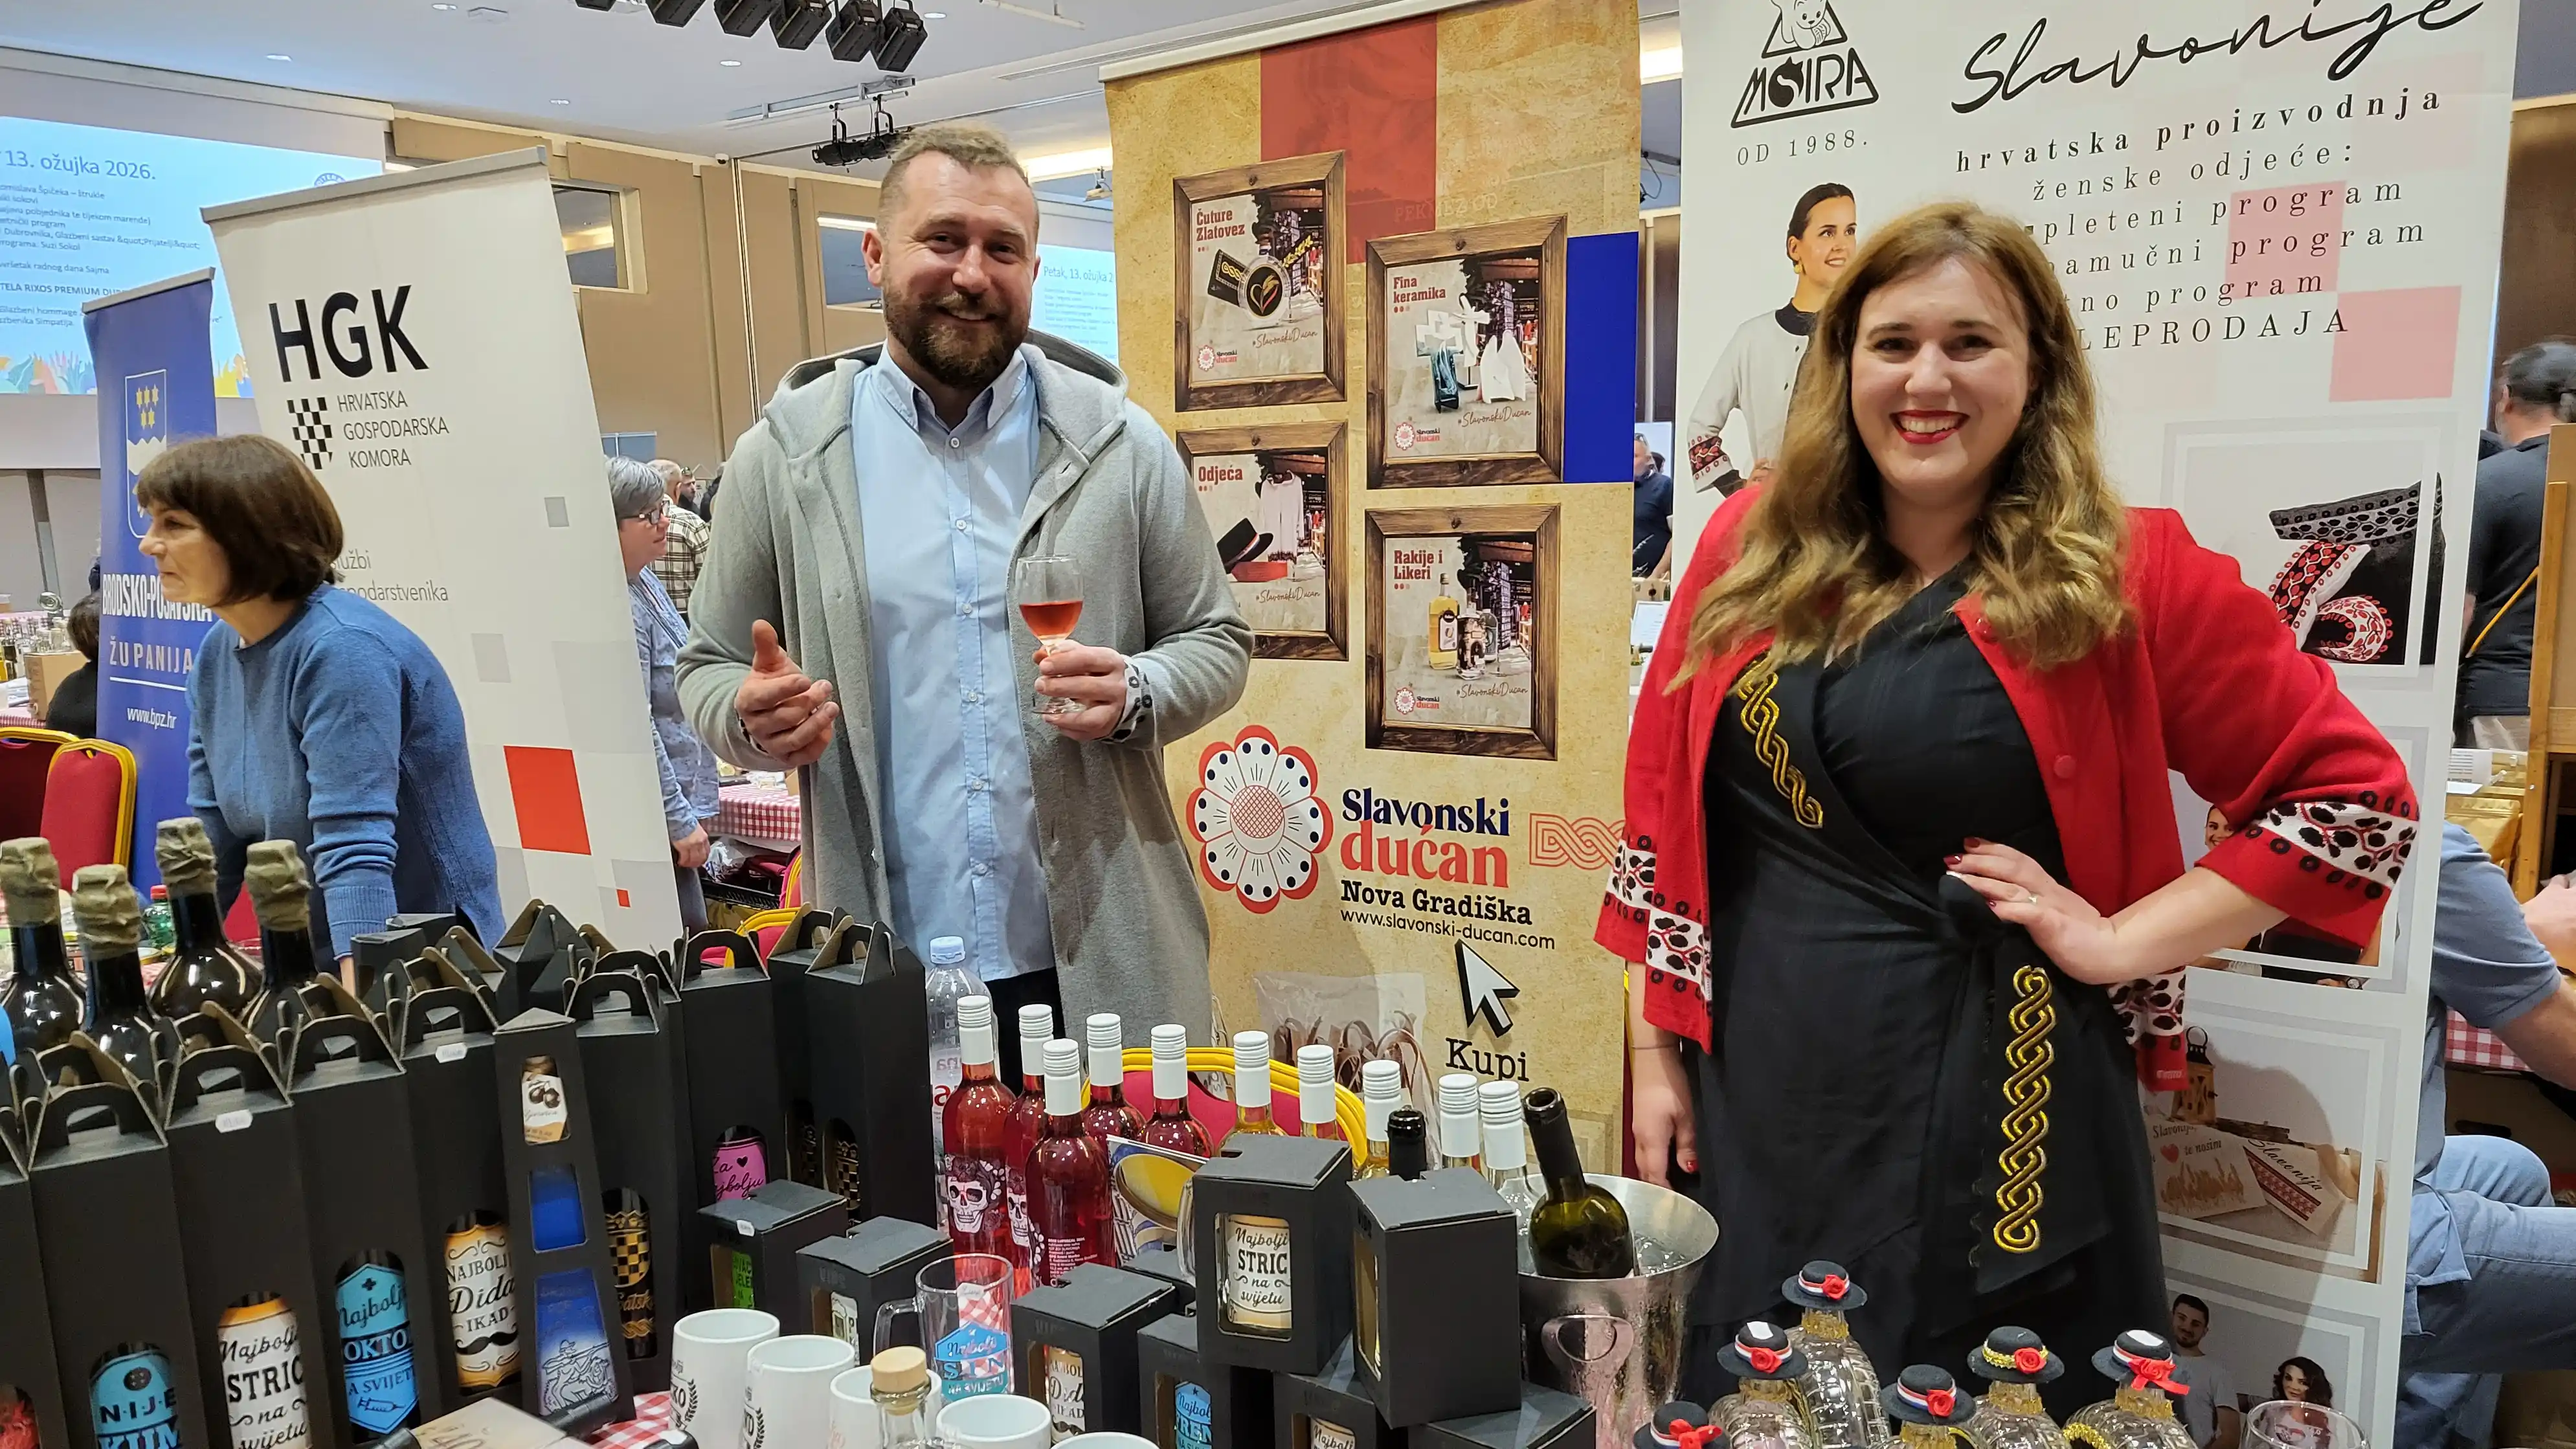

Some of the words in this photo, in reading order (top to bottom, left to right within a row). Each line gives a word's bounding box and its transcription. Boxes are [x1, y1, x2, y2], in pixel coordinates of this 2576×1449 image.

[1956, 131, 2129, 172] hrvatska
[2156, 87, 2440, 152] proizvodnja
[1737, 143, 1769, 166] OD
[1788, 129, 1867, 157] 1988.
[6, 150, 34, 168] 13.
[40, 153, 100, 176] ožujka
[104, 160, 156, 180] 2026.
[2033, 165, 2161, 201] ženske
[2190, 143, 2351, 181] odjeće:
[1196, 208, 1233, 227] Čuture
[2043, 200, 2182, 245] pleteni
[2210, 182, 2402, 226] program
[1196, 224, 1246, 242] Zlatovez
[2048, 238, 2201, 275] amučni
[2230, 223, 2424, 265] program
[0, 282, 23, 293] TELA
[24, 284, 52, 294] RIXOS
[54, 286, 100, 297] PREMIUM
[1393, 276, 1418, 289] Fina
[1393, 287, 1446, 304] keramika
[2145, 274, 2323, 313] program
[268, 284, 430, 383] HGK
[2078, 308, 2348, 350] LEPRODAJA
[336, 390, 409, 412] HRVATSKA
[342, 416, 450, 441] GOSPODARSKA
[348, 448, 412, 469] KOMORA
[1198, 464, 1243, 485] Odjeća
[335, 548, 372, 570] lužbi
[1393, 549, 1435, 567] Rakije
[1438, 548, 1443, 565] i
[1393, 565, 1431, 581] Likeri
[109, 635, 194, 675] ŽUPANIJA
[127, 706, 176, 730] www.bpz.hr
[1341, 787, 1510, 837] Slavonski
[1339, 820, 1510, 889] dućan
[1340, 879, 1405, 910] Nova
[1411, 887, 1533, 926] Gradiška
[1339, 909, 1555, 950] www.slavonski-ducan.com
[1444, 1037, 1530, 1083] Kupi
[1235, 1226, 1290, 1251] Najbolji
[1237, 1250, 1288, 1275] STRIC
[447, 1274, 515, 1314] Dida
[1251, 1277, 1270, 1289] na
[1240, 1290, 1284, 1309] svijetu
[220, 1324, 298, 1364] Najbolj
[343, 1328, 408, 1362] OKTO
[258, 1404, 287, 1424] na
